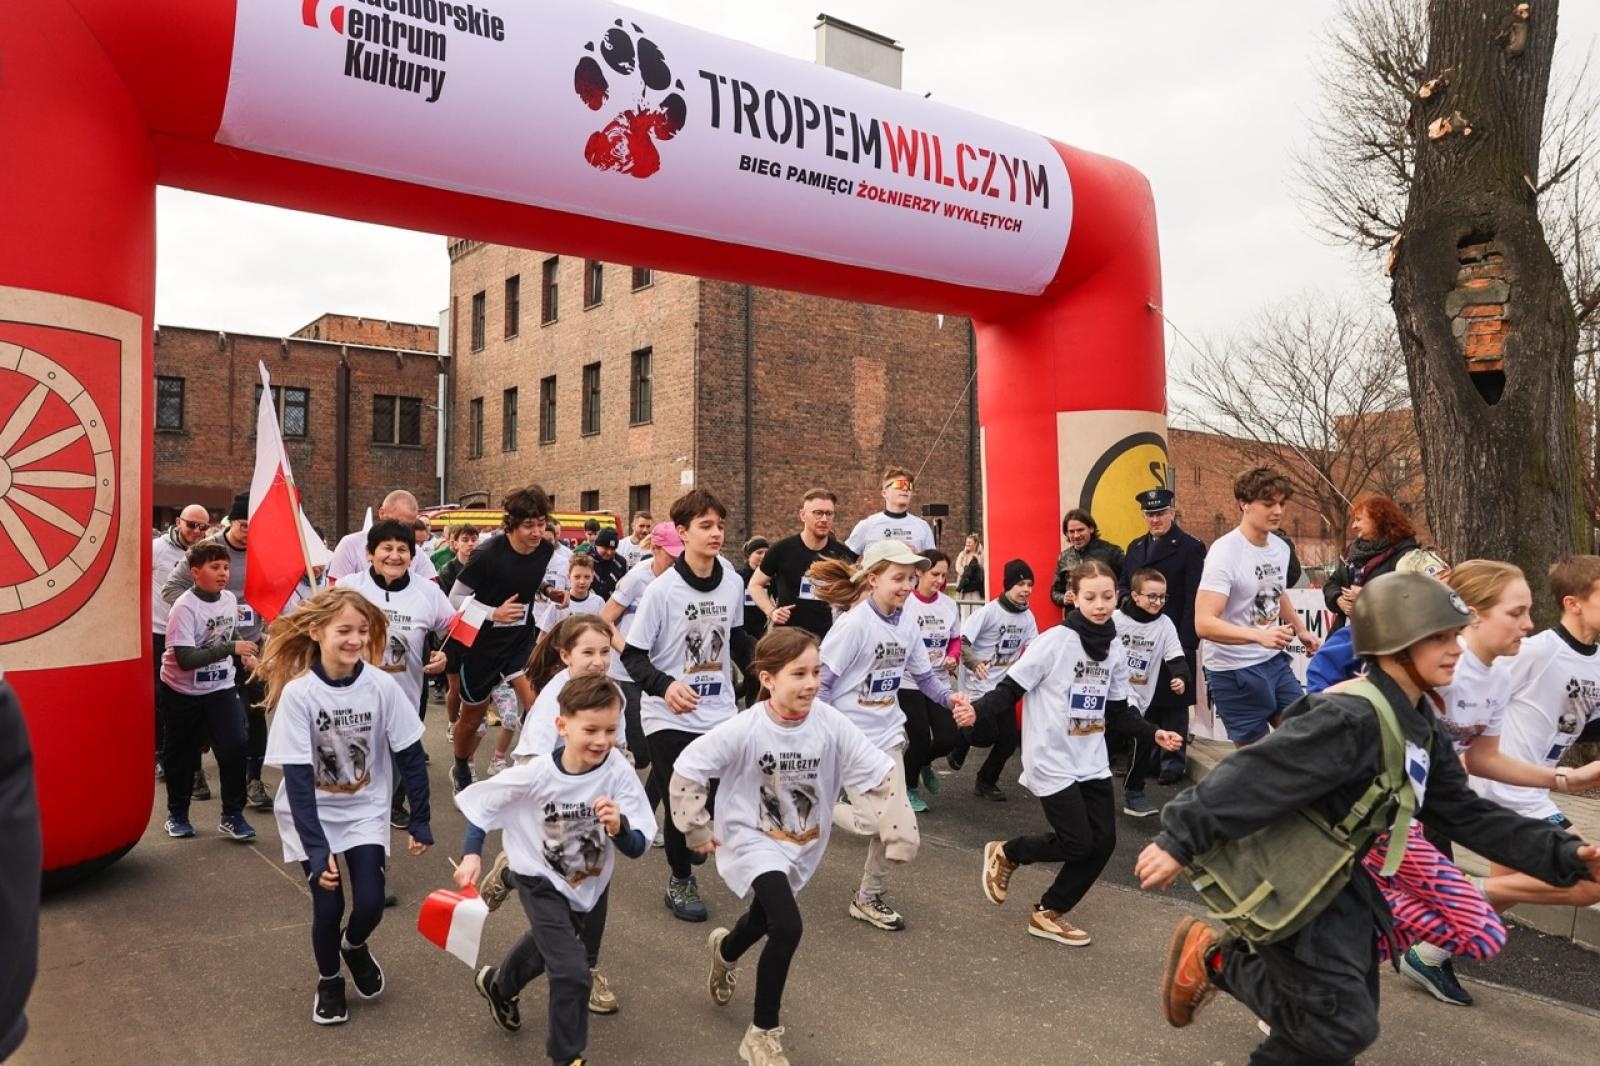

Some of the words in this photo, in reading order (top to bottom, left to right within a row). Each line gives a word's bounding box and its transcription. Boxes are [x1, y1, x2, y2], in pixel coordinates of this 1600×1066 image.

[347, 8, 447, 62] entrum
[357, 0, 505, 42] borskie
[344, 39, 446, 103] Kultury
[698, 69, 1050, 209] TROPEMWILCZYM
[739, 154, 782, 178] BIEG
[785, 166, 854, 196] PAMIĘCI
[856, 179, 941, 215] ŻOŁNIERZY
[943, 203, 1023, 232] WYKLĘTYCH
[208, 671, 221, 681] 12
[697, 684, 711, 696] 11
[880, 679, 894, 691] 69
[1083, 695, 1097, 710] 89
[334, 712, 371, 726] WILCZYM
